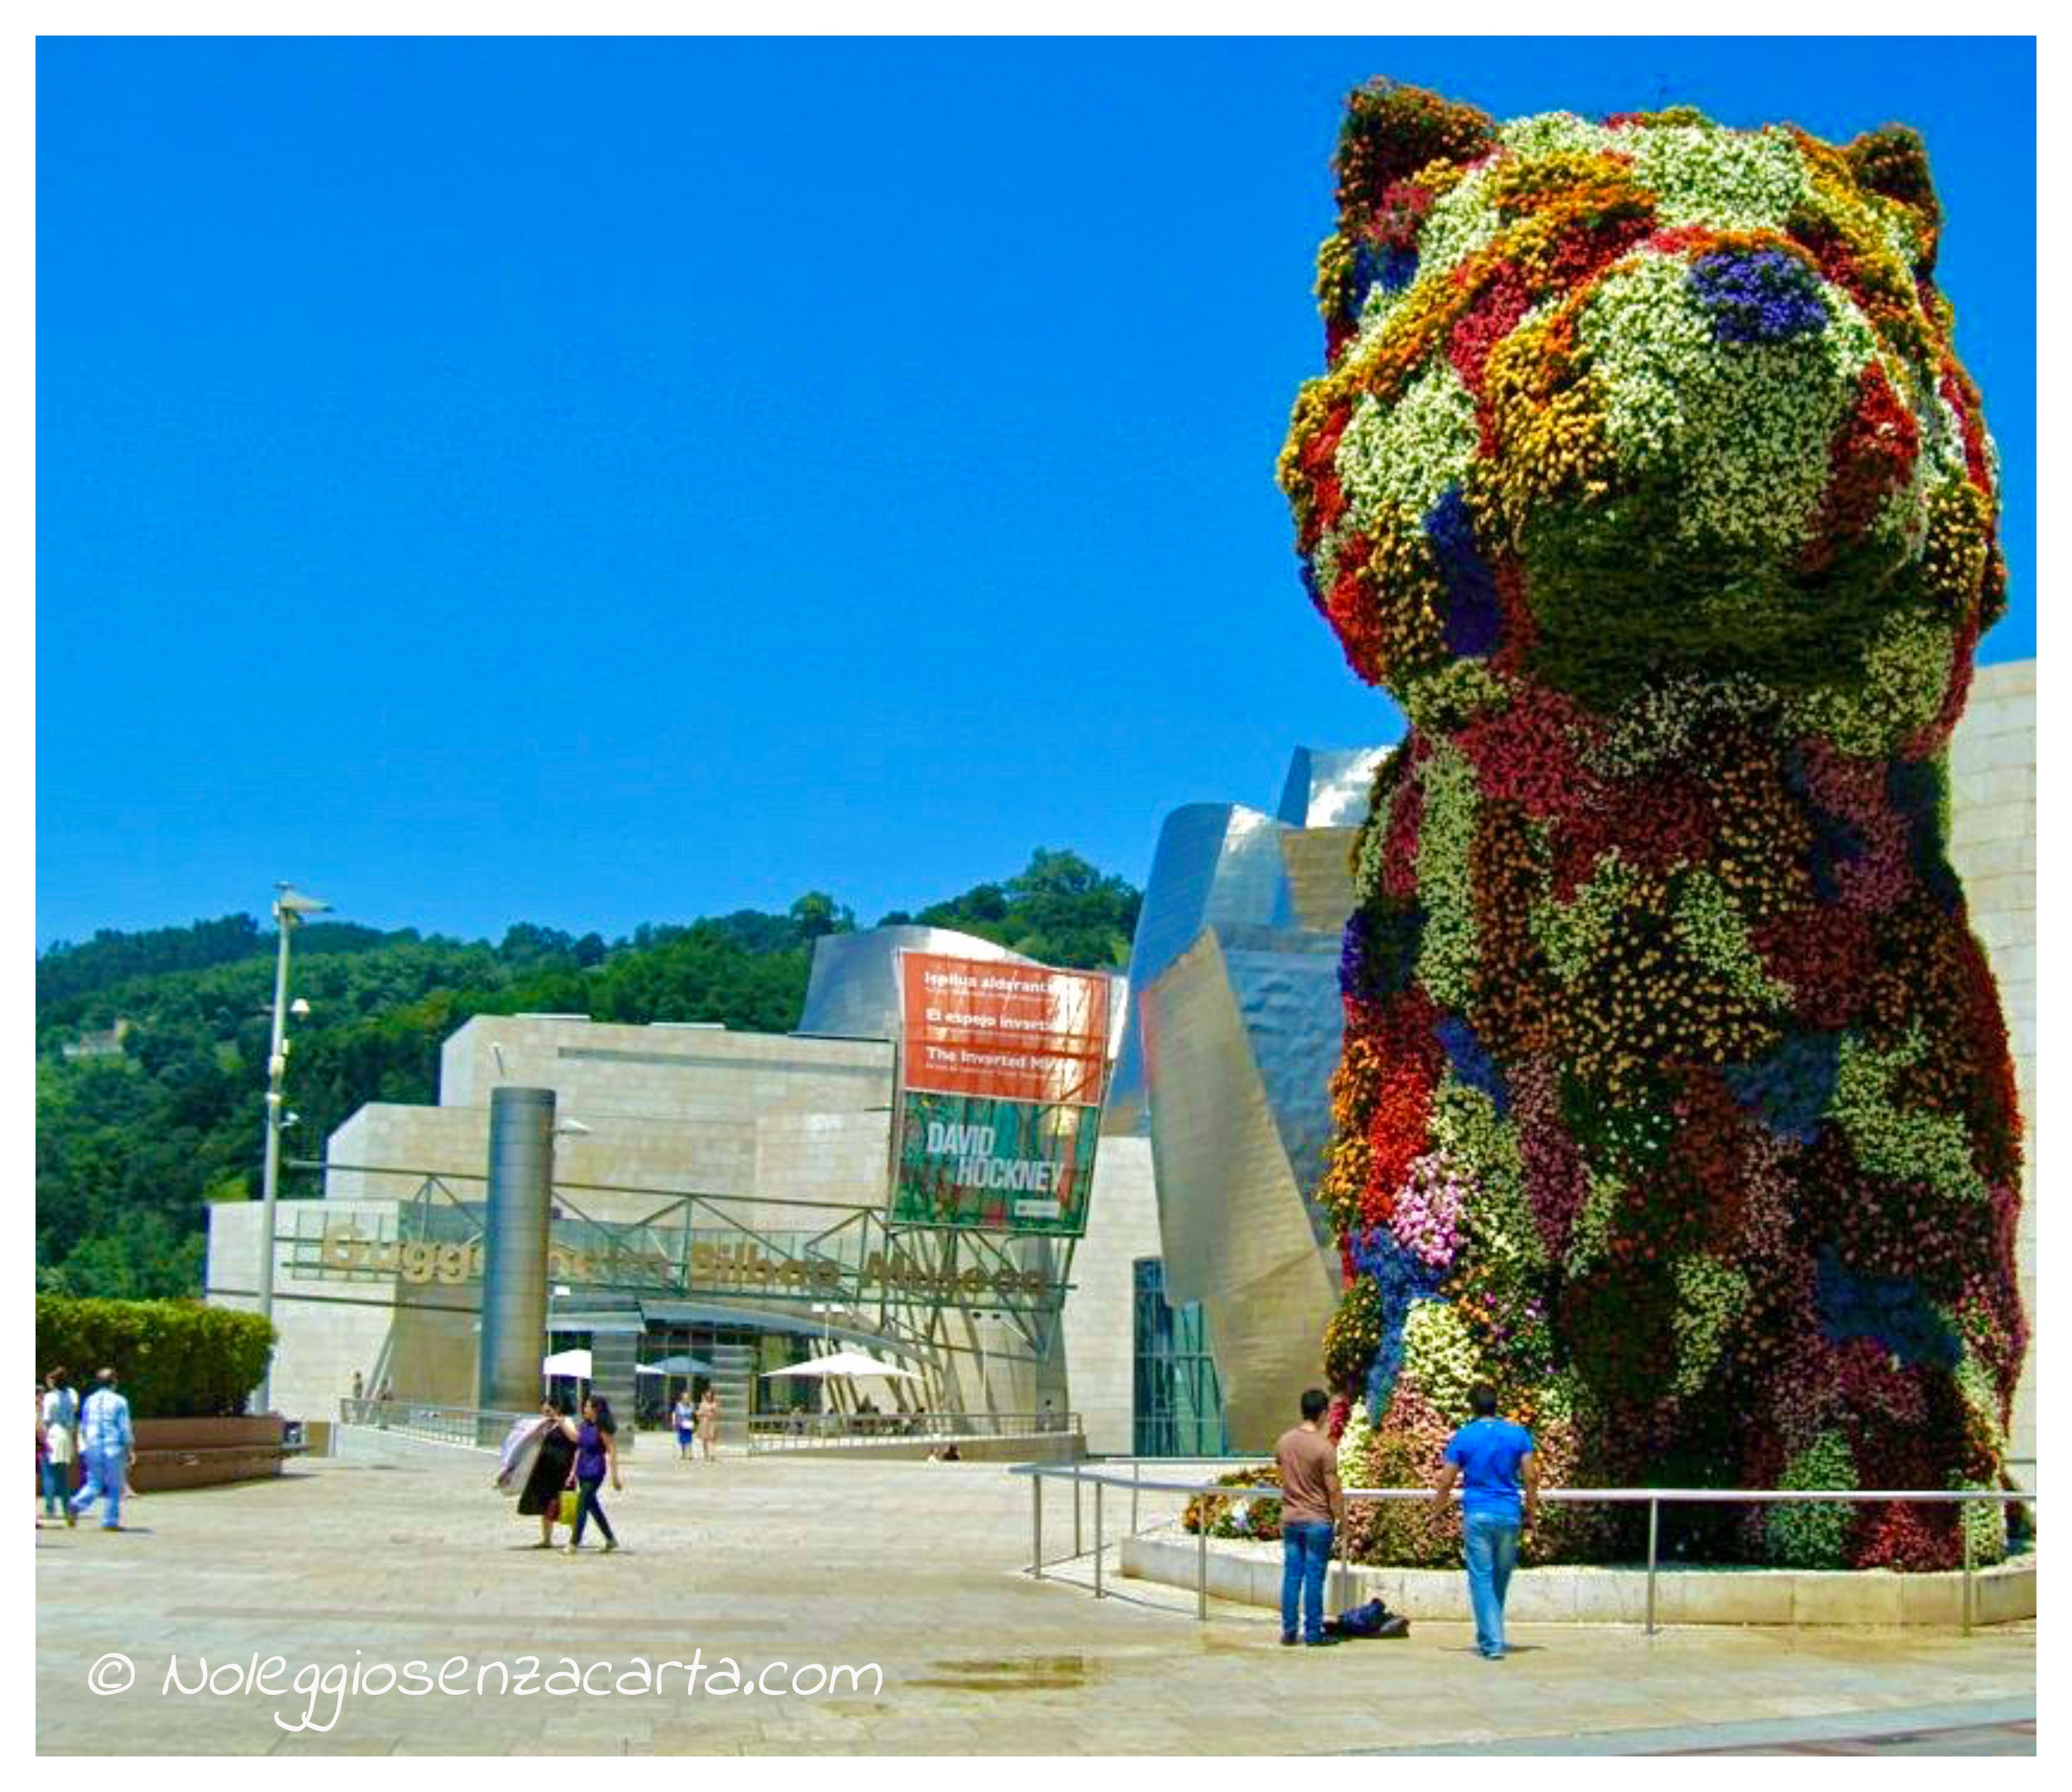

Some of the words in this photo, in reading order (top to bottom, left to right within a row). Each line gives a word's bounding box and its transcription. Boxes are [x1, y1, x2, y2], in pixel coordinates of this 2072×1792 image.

[926, 1007, 942, 1022] El
[926, 1046, 957, 1063] The
[926, 1122, 995, 1156] DAVID
[957, 1156, 1065, 1193] HOCKNEY
